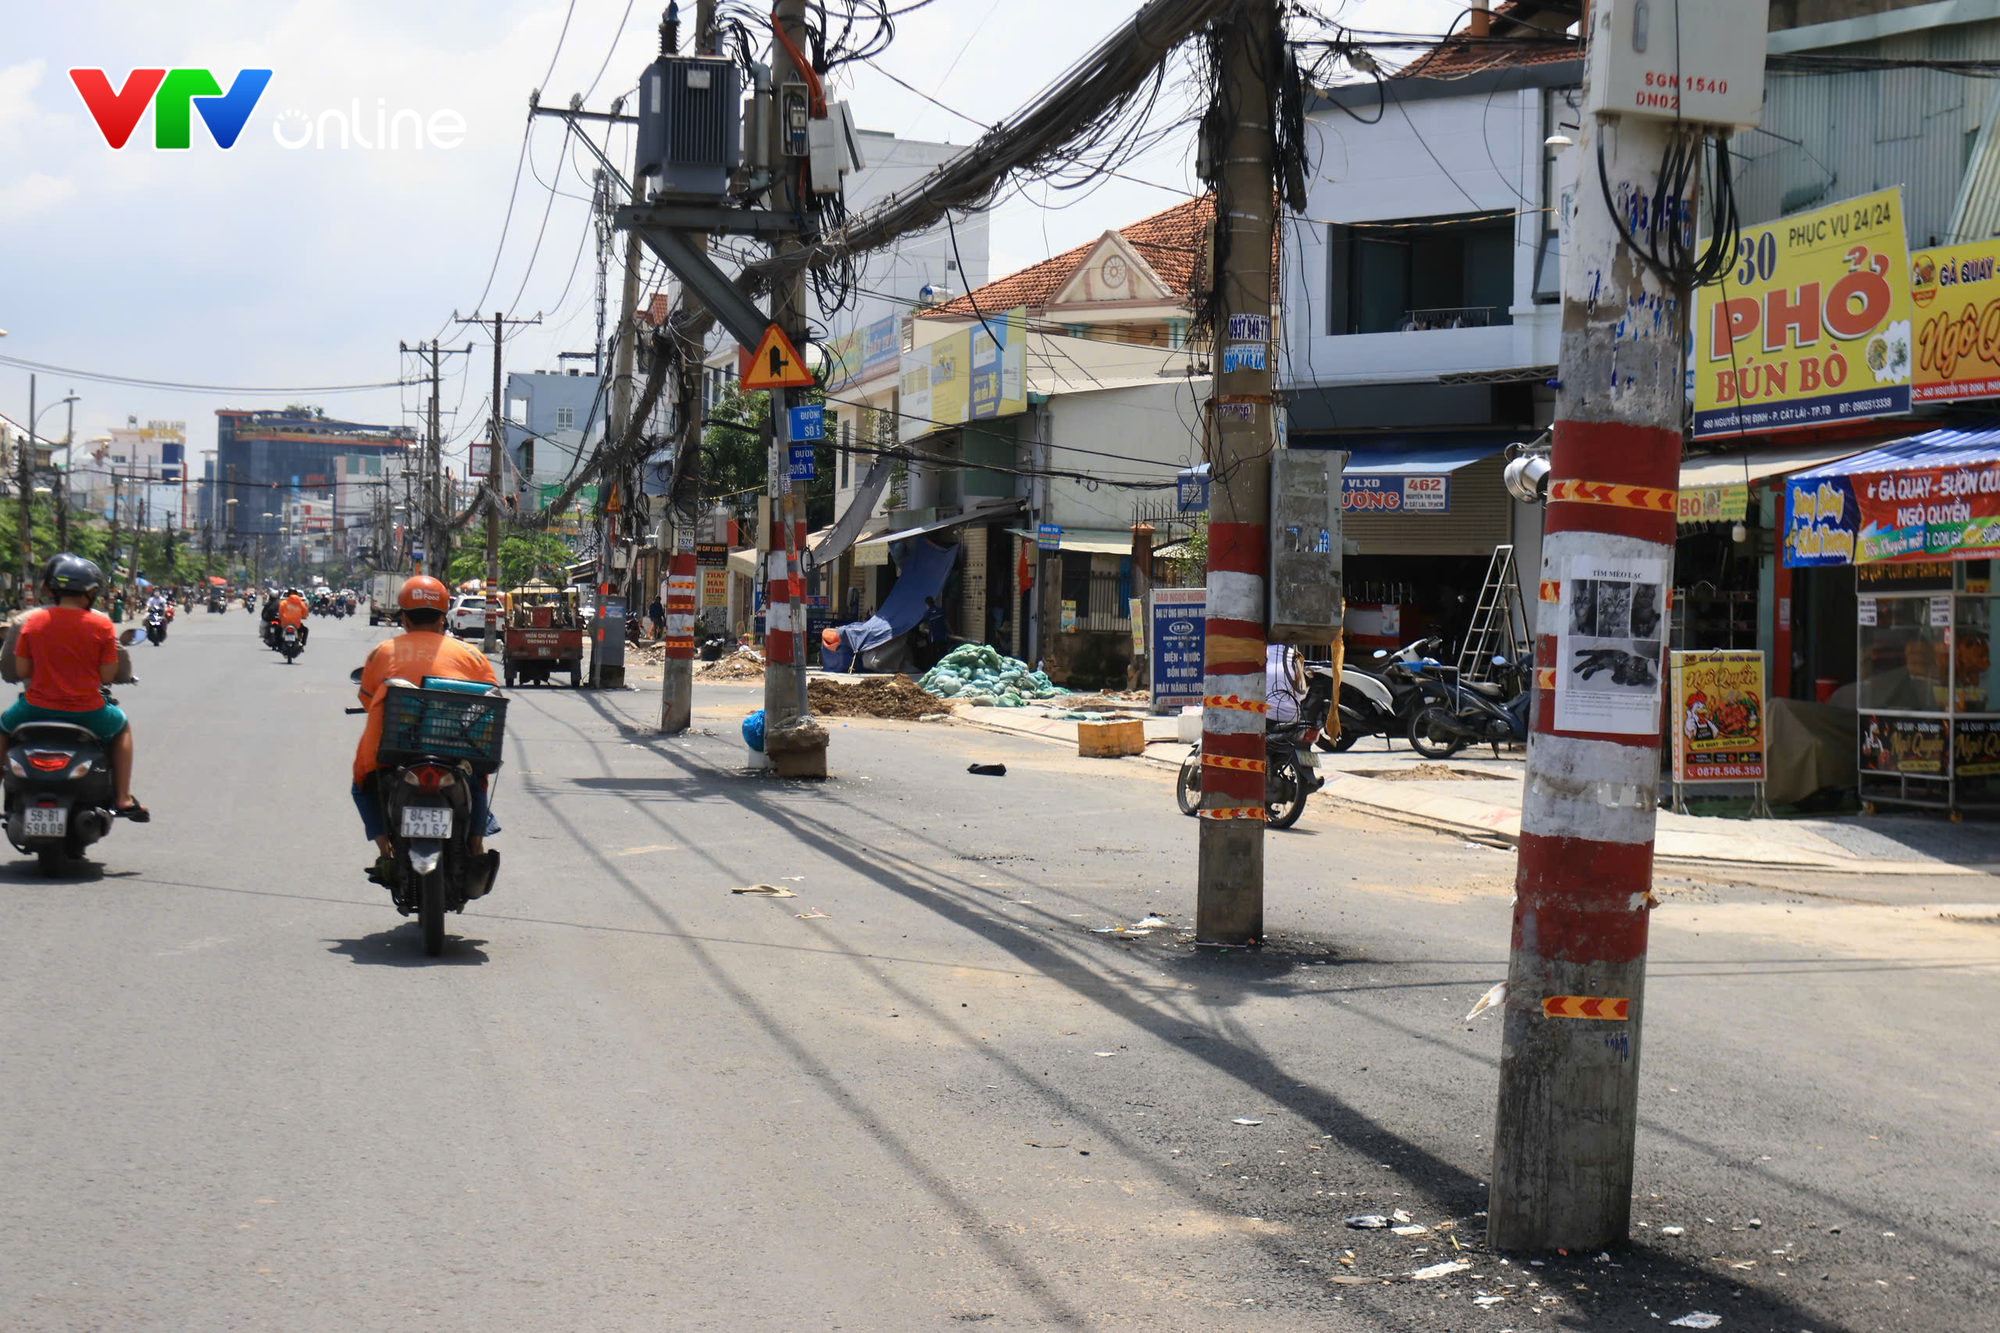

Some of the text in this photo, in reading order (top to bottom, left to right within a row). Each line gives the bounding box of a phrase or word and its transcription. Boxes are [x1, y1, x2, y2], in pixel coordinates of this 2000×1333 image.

[1645, 71, 1728, 95] SGN 1540
[1636, 91, 1679, 110] DN02
[1788, 201, 1891, 248] PHỤC VỤ 24/24
[1738, 231, 1776, 286] 30
[1940, 256, 1995, 287] GÀ QUAY
[1710, 245, 1892, 361] PHỞ
[1919, 302, 1978, 379] Ngô
[1715, 343, 1848, 404] BÚN BÒ
[1714, 412, 1741, 429] NGUYỄN
[1741, 415, 1752, 427] THỊ
[1752, 412, 1769, 425] ĐỊNH
[1780, 407, 1795, 420] CÁT
[1795, 405, 1807, 419] LÁI
[804, 421, 820, 437] SỐ 5
[1348, 479, 1380, 488] VLXD
[1408, 479, 1441, 491] 462
[1879, 476, 1895, 501] GÀ
[1897, 476, 1932, 500] QUAY
[1940, 469, 1978, 496] SƯỜN
[1680, 492, 1701, 517] BÒ
[1927, 497, 1971, 524] QUYỀN
[1592, 568, 1644, 580] TÌM MÈO LẠC
[1164, 651, 1200, 664] ĐIỆN NƯỚC
[1180, 667, 1197, 678] NƯỚC
[1156, 682, 1169, 693] MÁY
[1170, 682, 1187, 693] NĂNG
[1697, 765, 1762, 777] 0878.506.350
[409, 809, 444, 823] 84-E1
[405, 823, 448, 837] 121.62
